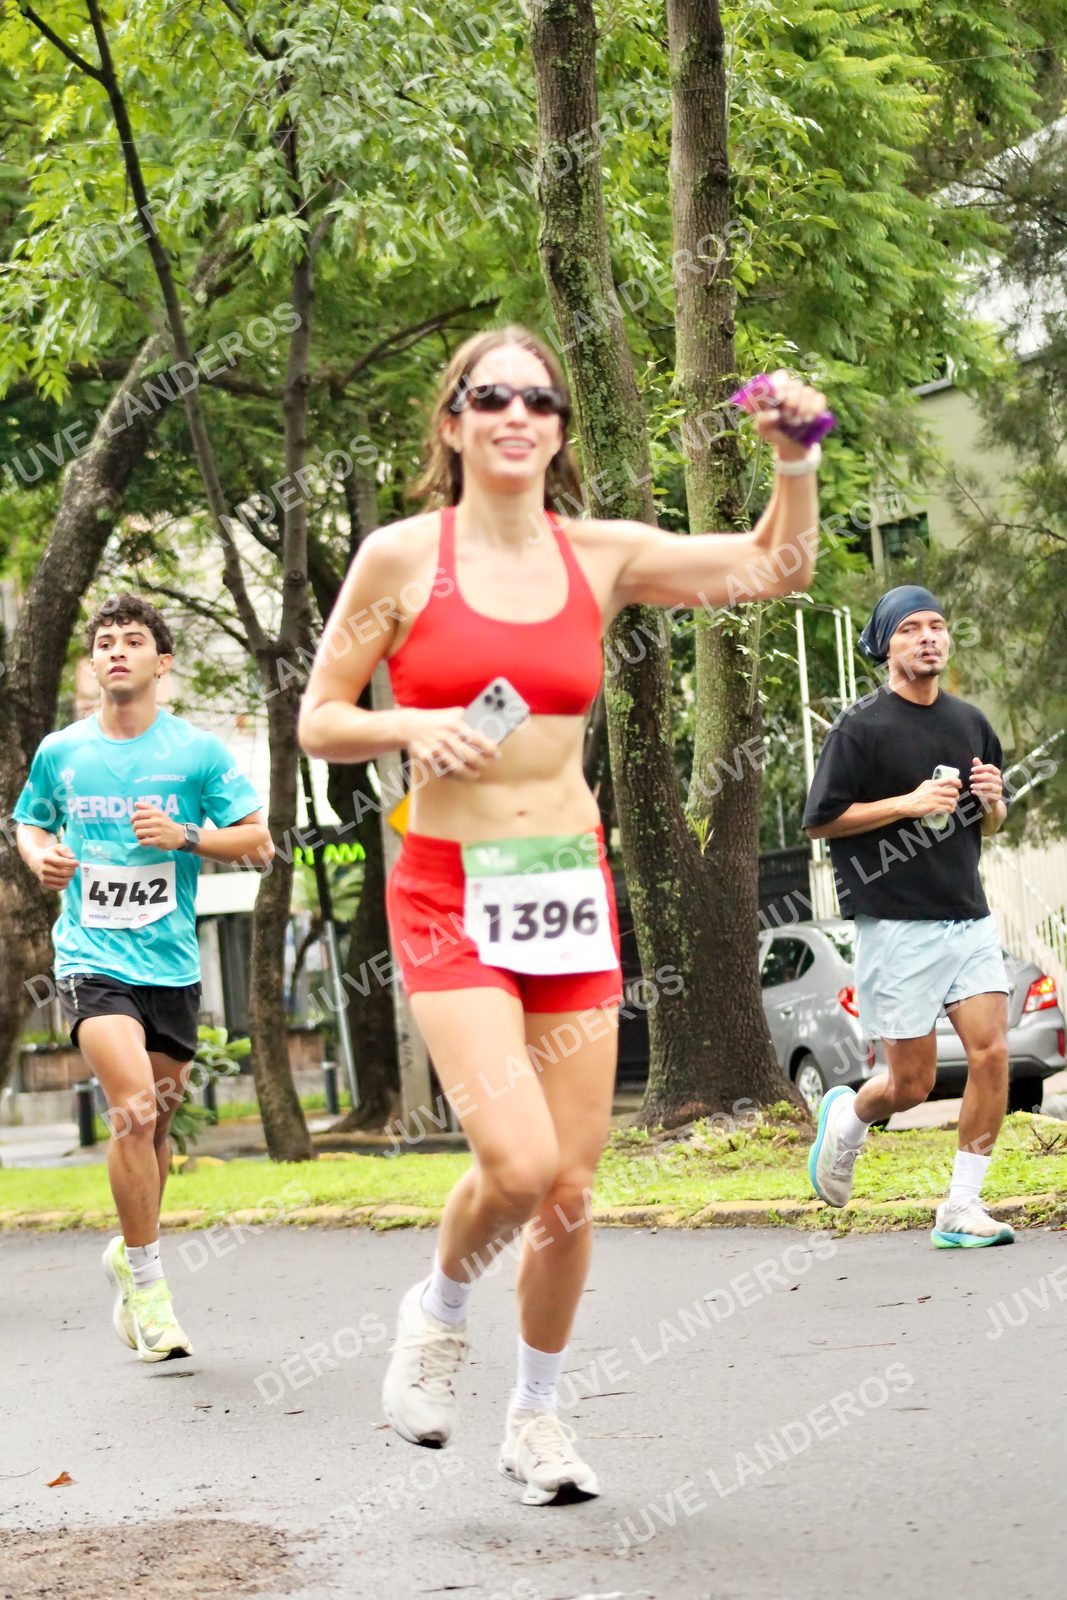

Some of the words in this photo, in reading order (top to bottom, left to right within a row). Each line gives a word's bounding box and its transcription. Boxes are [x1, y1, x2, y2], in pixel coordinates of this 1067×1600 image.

[66, 794, 181, 820] PERDURA
[88, 877, 169, 907] 4742
[483, 897, 599, 943] 1396
